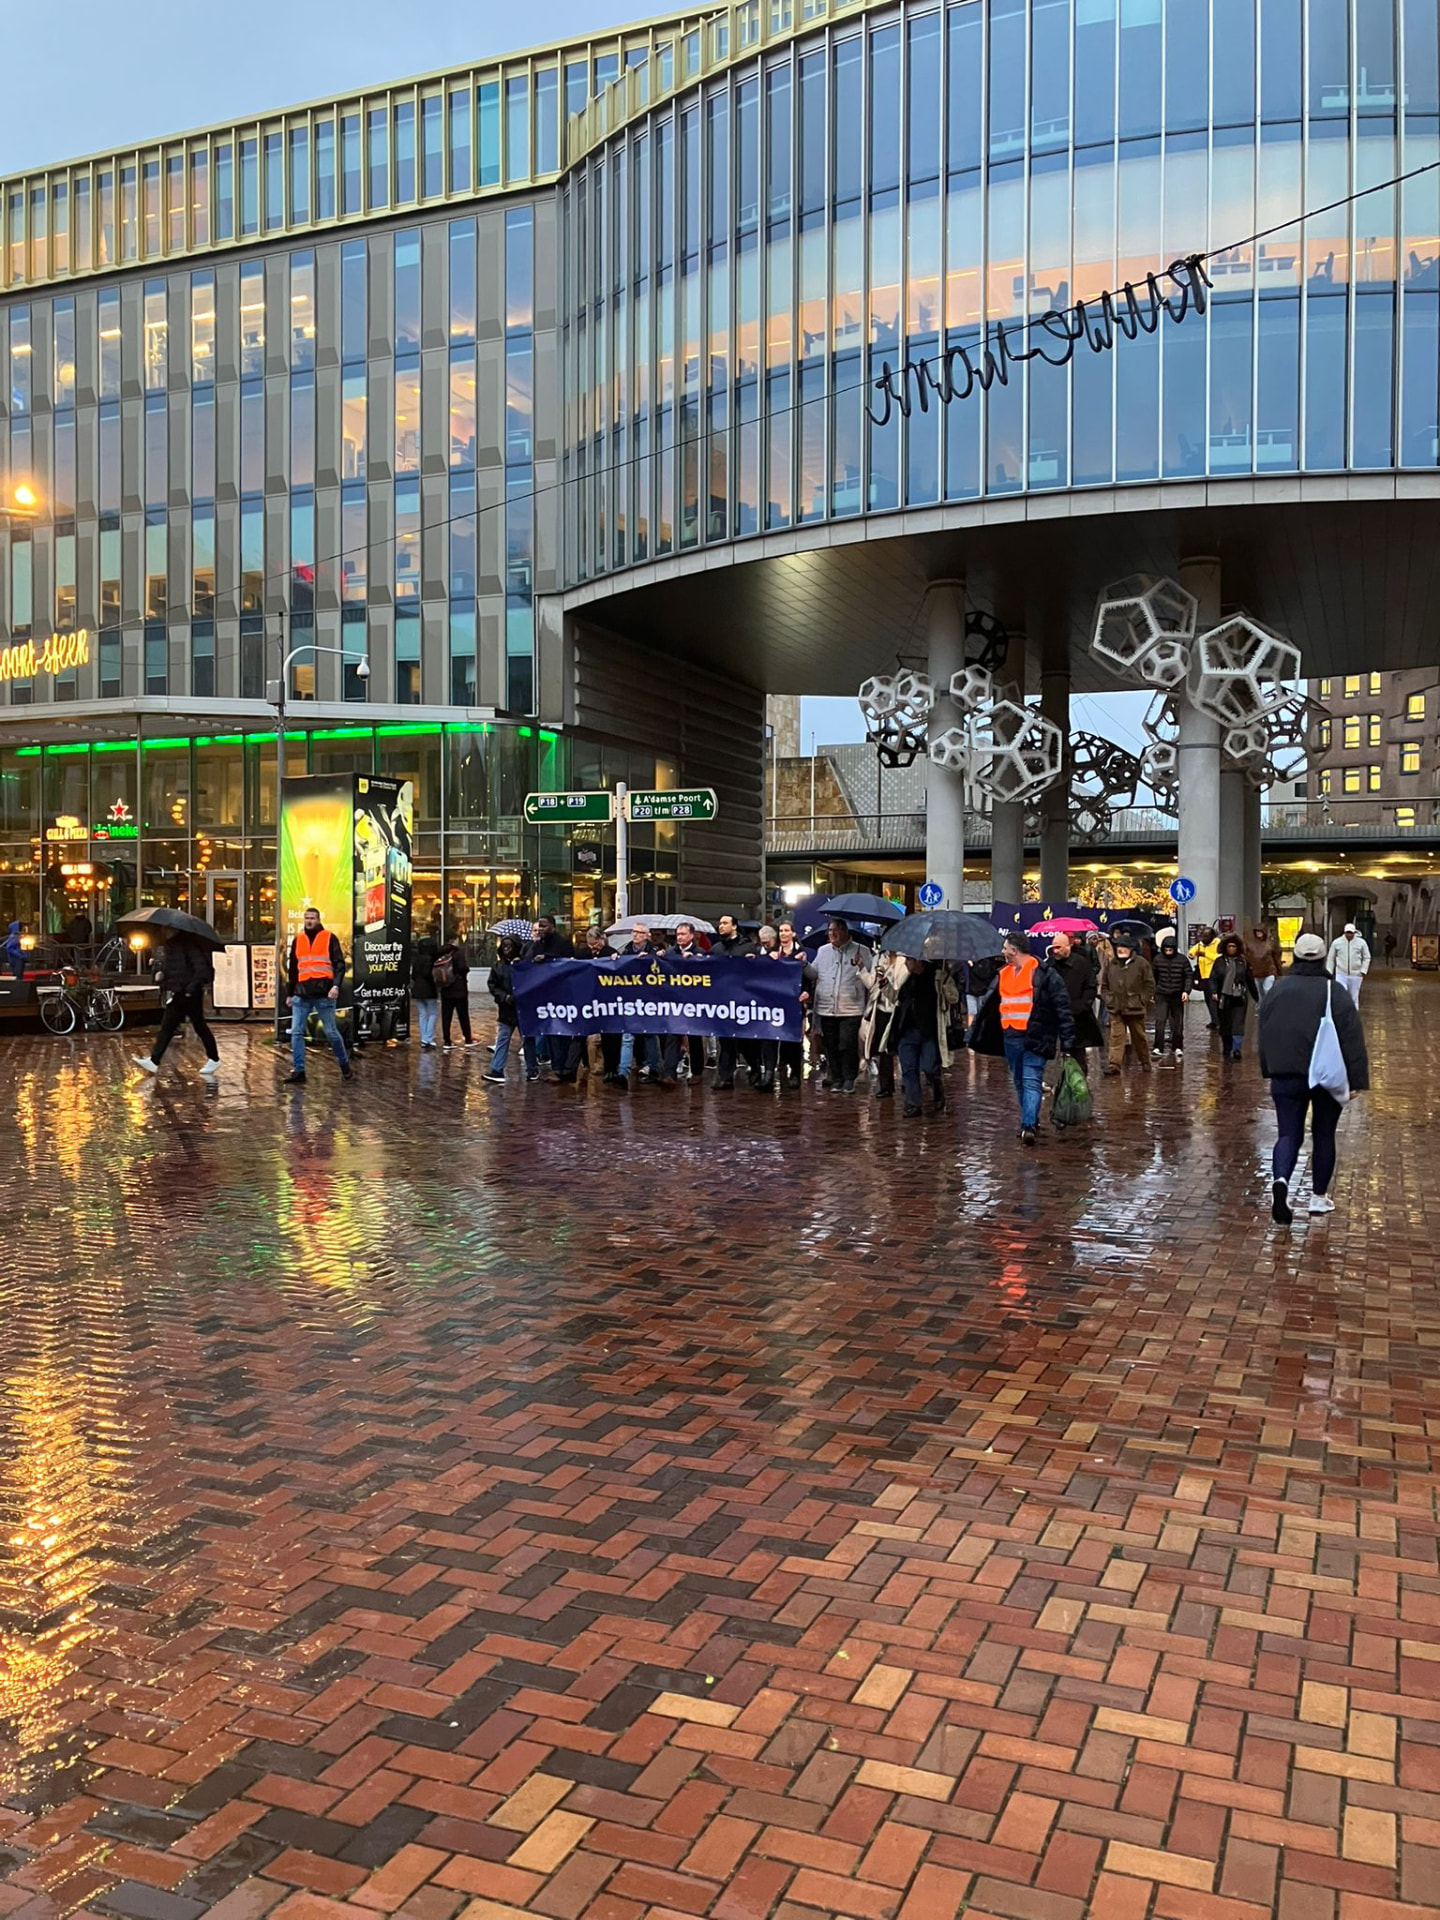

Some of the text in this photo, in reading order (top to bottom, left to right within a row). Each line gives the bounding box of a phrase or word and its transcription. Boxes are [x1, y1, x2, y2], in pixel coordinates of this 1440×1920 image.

[540, 798, 555, 806] P18
[568, 797, 584, 806] P19
[643, 794, 702, 804] A'damse Poort
[634, 805, 690, 816] P20 t/m P28
[93, 824, 139, 837] Heineke
[364, 941, 403, 952] Discover the
[365, 951, 402, 964] very best of
[368, 962, 398, 974] your ADE
[598, 974, 712, 987] WALK OF HOPE
[361, 988, 372, 997] Get
[372, 988, 382, 997] the
[382, 987, 394, 997] ADE
[536, 997, 785, 1026] stop christenvervolging
